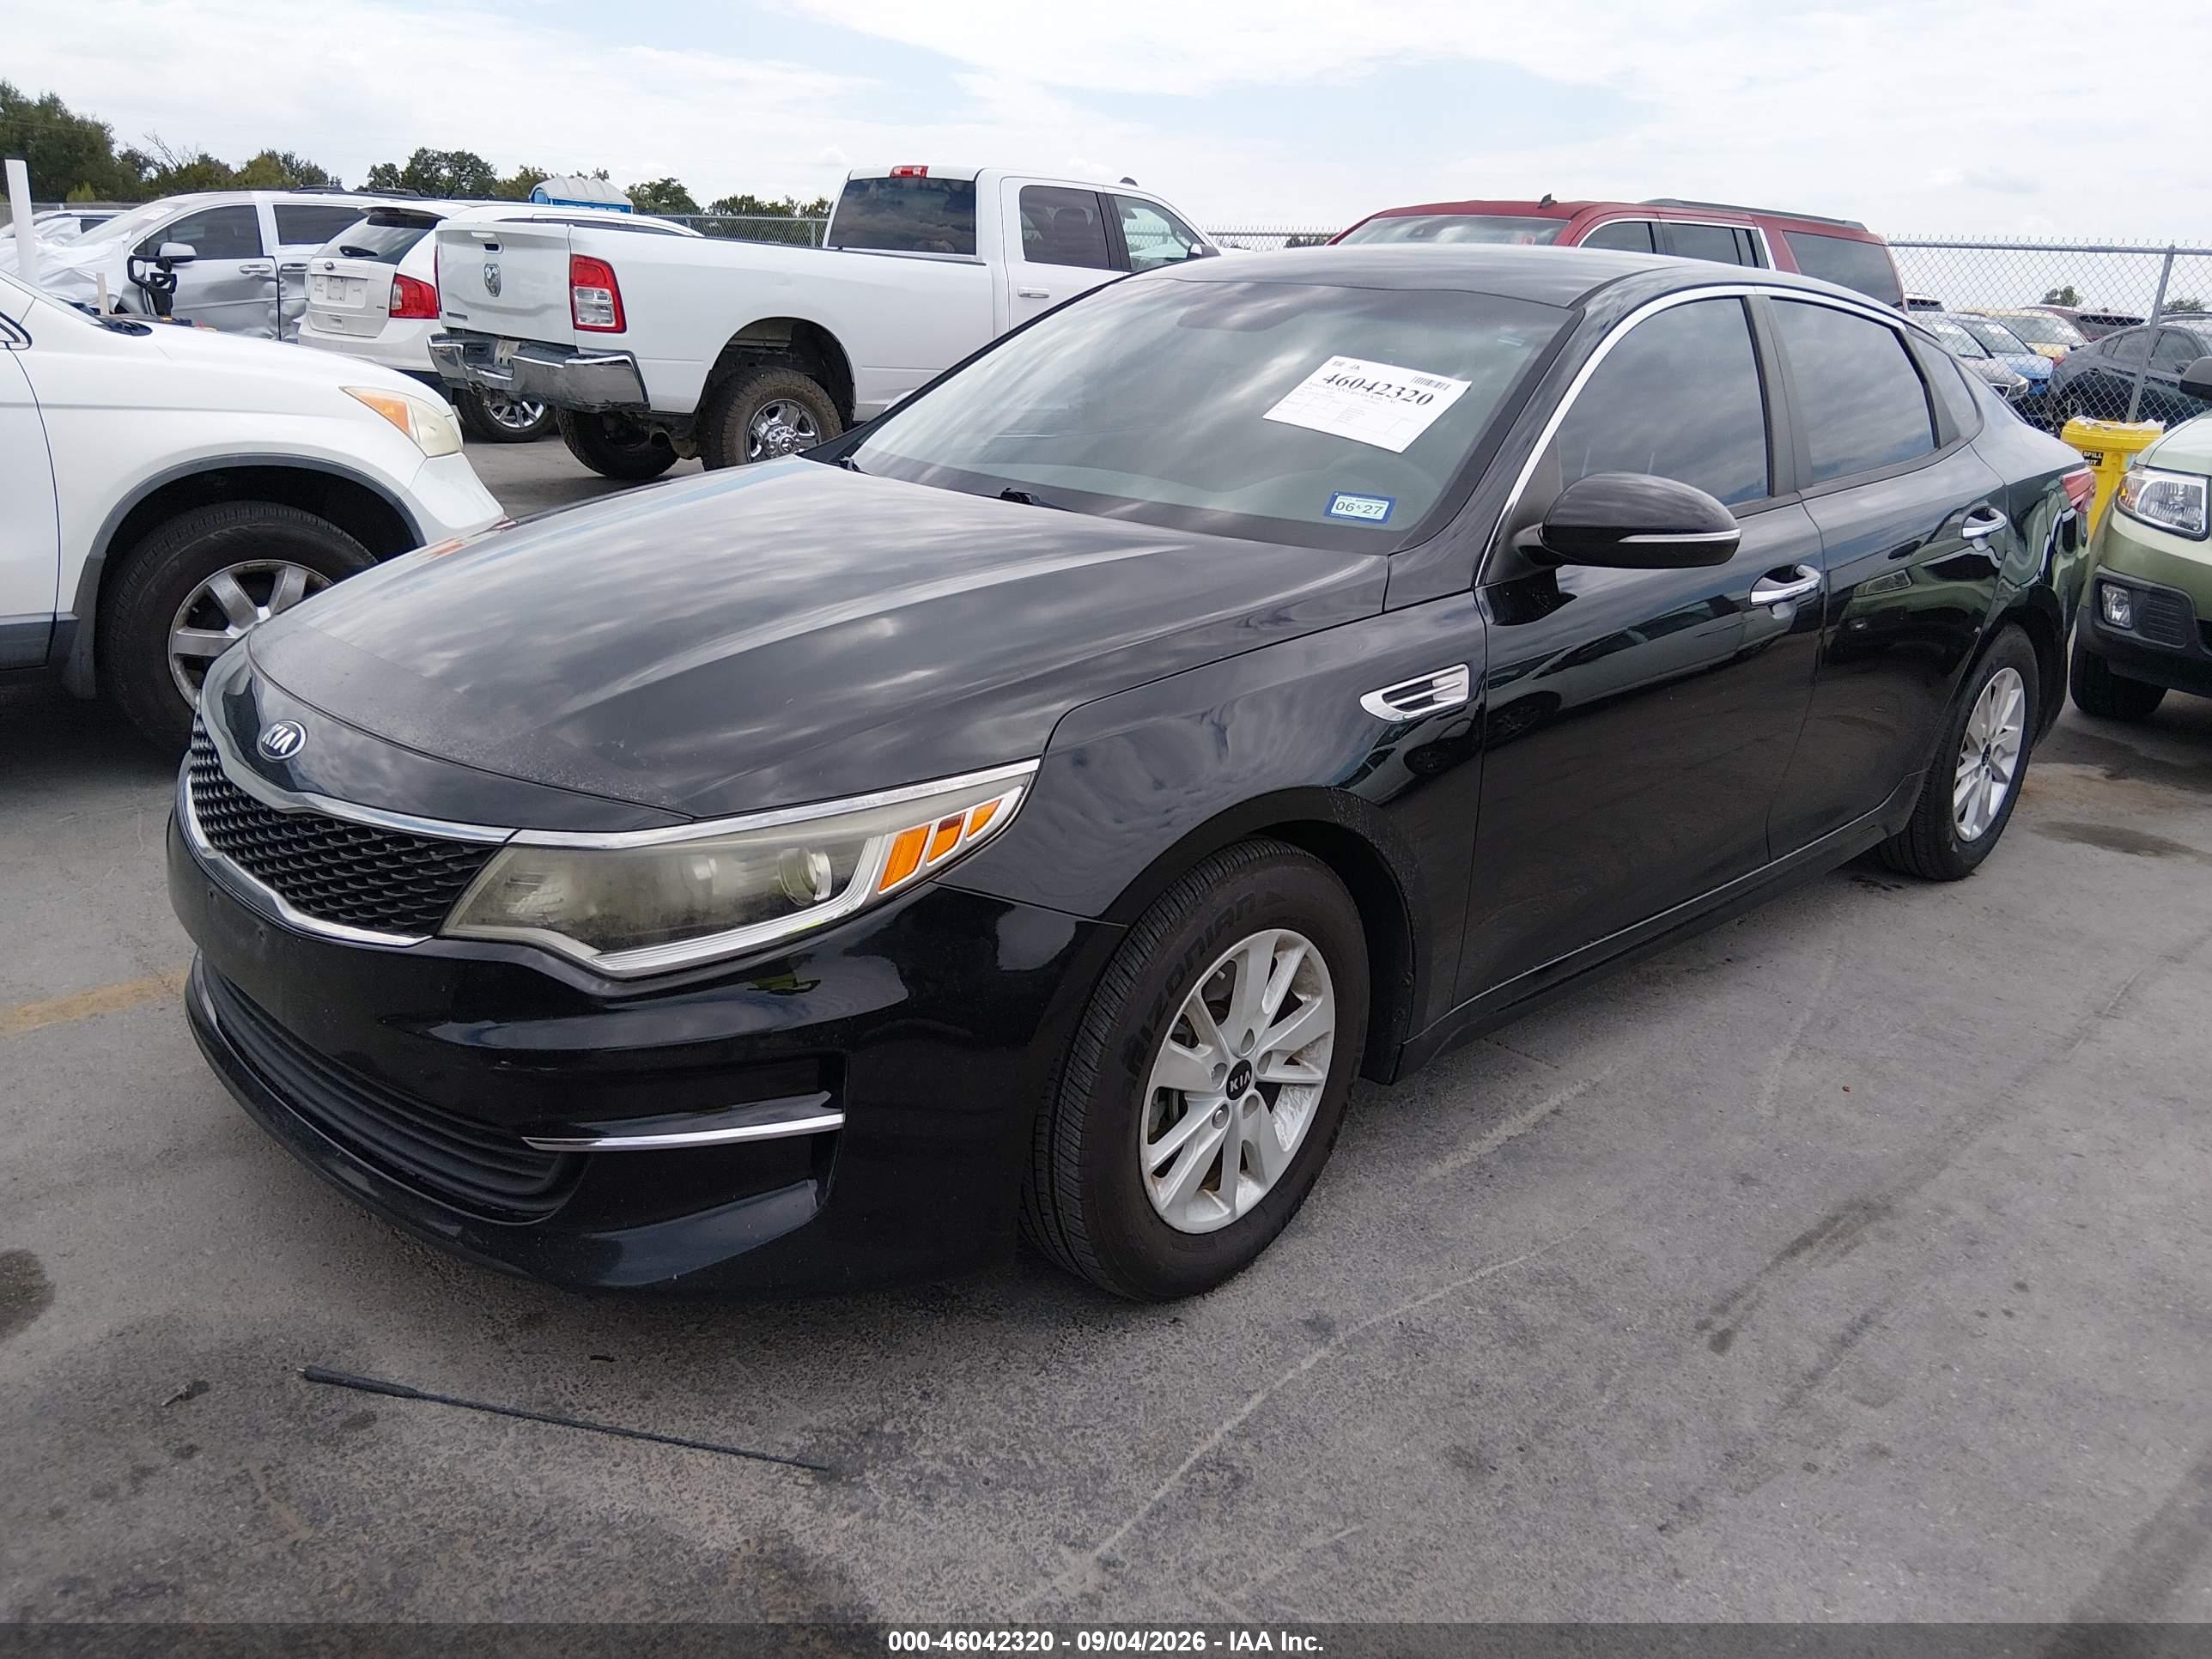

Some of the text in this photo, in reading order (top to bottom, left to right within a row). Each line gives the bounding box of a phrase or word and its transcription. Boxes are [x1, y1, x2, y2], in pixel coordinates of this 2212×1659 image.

[1322, 374, 1434, 406] 46042320
[1335, 501, 1355, 512] 06
[1362, 504, 1383, 515] 27
[261, 722, 297, 755] KIA
[1230, 1070, 1251, 1093] KIA
